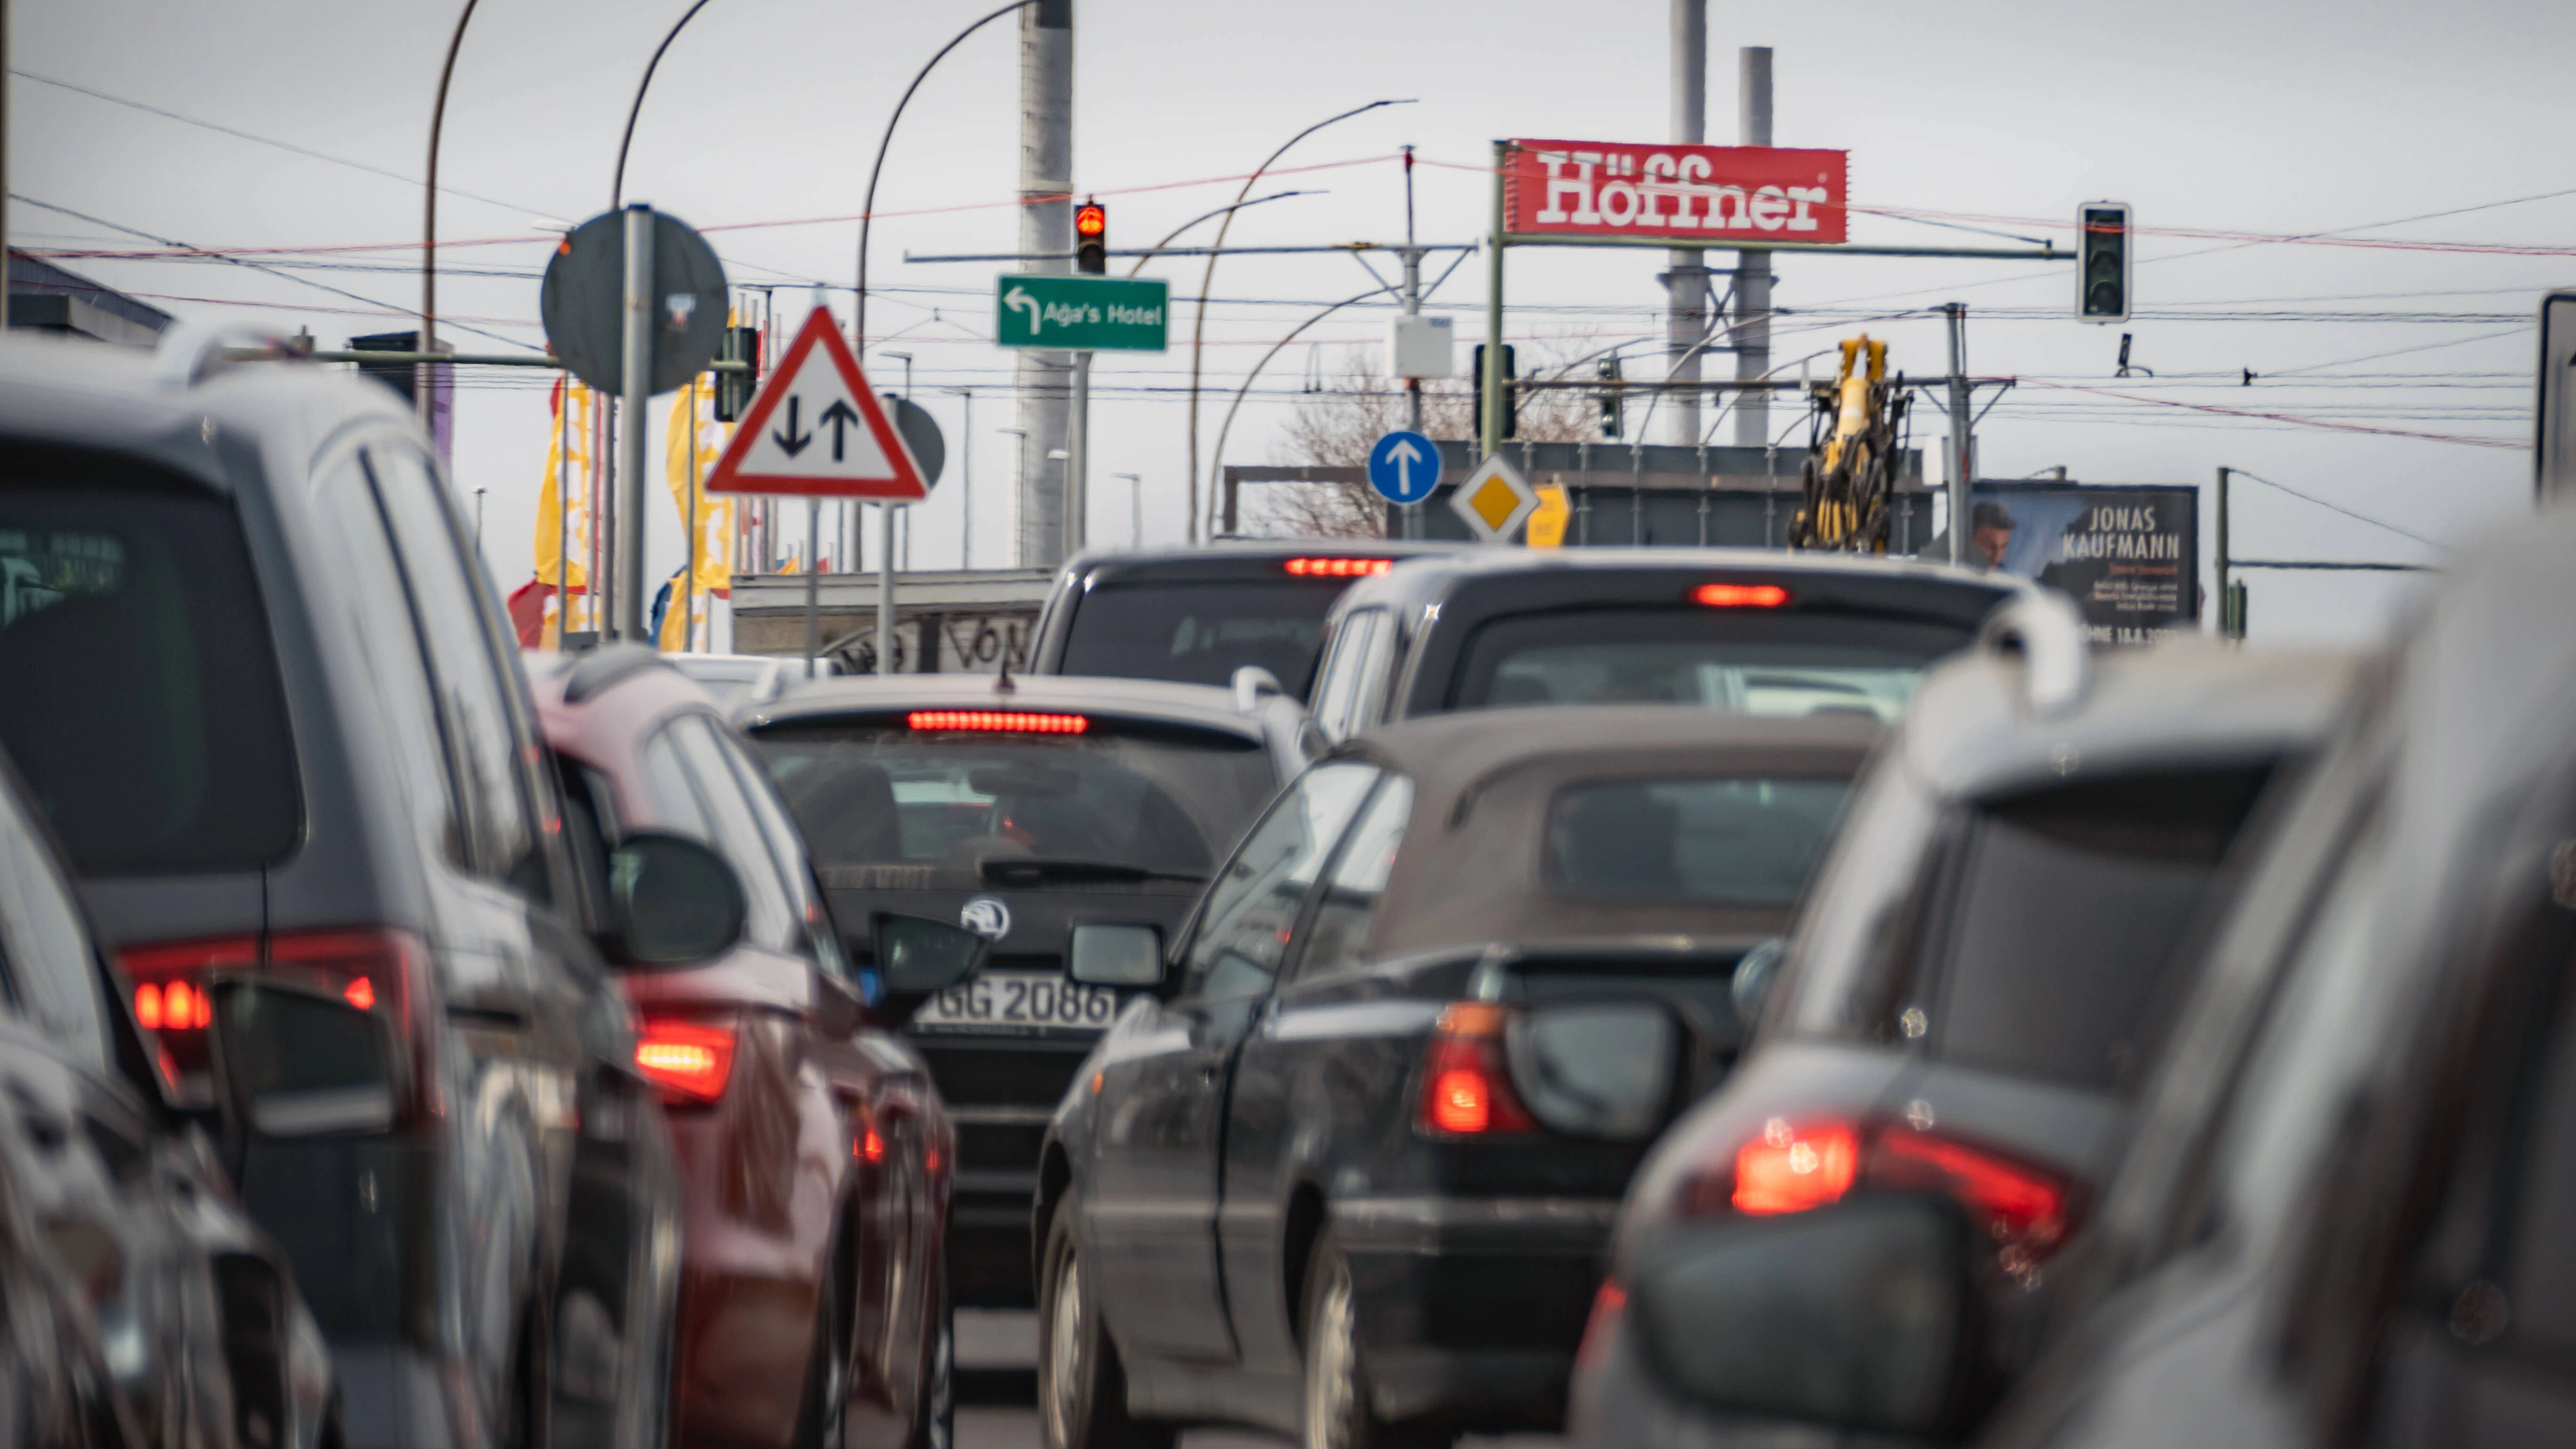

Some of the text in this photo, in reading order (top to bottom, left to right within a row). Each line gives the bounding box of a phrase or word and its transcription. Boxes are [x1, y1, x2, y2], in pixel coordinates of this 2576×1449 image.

[1536, 151, 1827, 231] Höffner
[1107, 303, 1163, 326] Hotel
[2089, 506, 2156, 532] JONAS
[2062, 533, 2180, 560] KAUFMANN
[1004, 981, 1109, 1022] 2086
